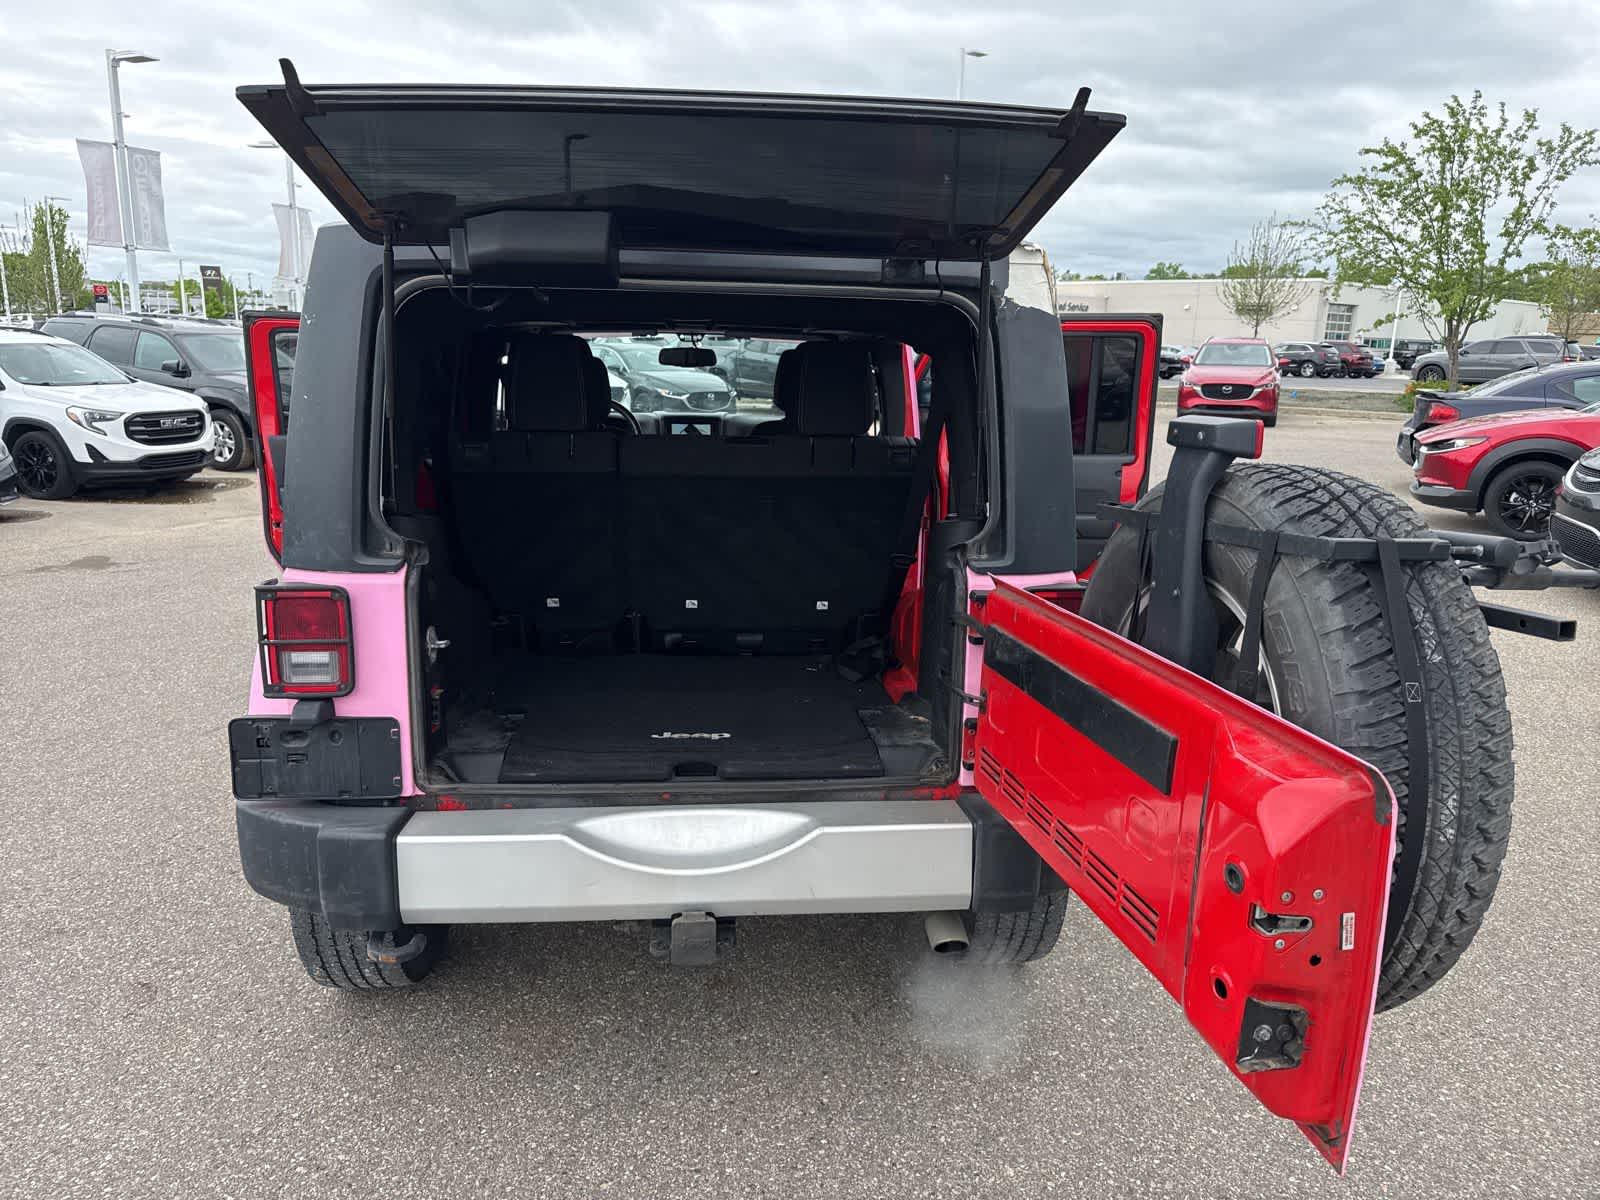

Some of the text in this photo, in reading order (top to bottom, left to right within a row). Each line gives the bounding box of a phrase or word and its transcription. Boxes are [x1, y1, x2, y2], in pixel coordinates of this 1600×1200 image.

[1067, 301, 1089, 312] Service
[160, 418, 187, 429] GMC
[650, 731, 731, 740] Jeep
